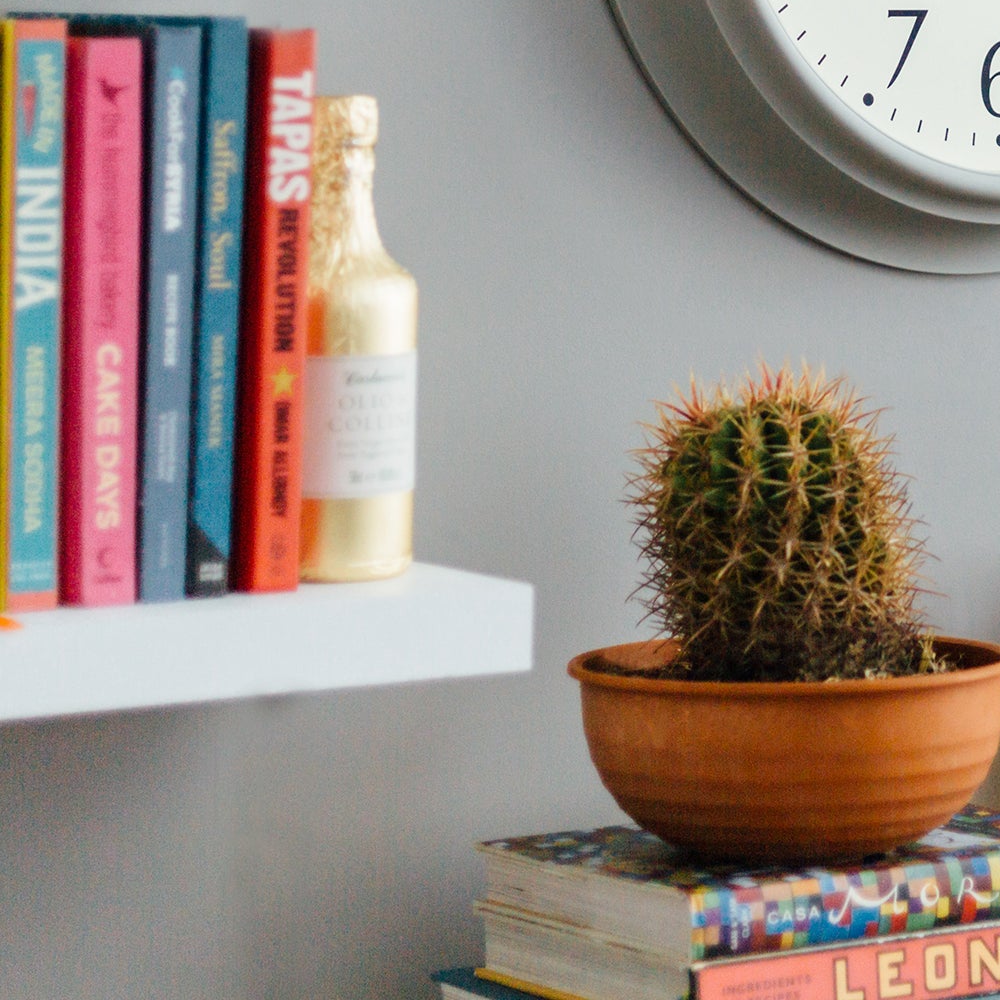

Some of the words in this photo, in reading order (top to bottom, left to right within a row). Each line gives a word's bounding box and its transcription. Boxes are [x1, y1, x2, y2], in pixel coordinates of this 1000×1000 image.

[887, 9, 929, 89] 7
[268, 70, 313, 203] TAPAS
[14, 167, 60, 310] INDIA
[272, 209, 299, 353] REVOLUTION
[24, 344, 45, 437] MEERA
[97, 343, 122, 436] CAKE
[23, 443, 44, 534] SODHA
[96, 445, 121, 531] DAYS
[766, 905, 821, 925] CASA
